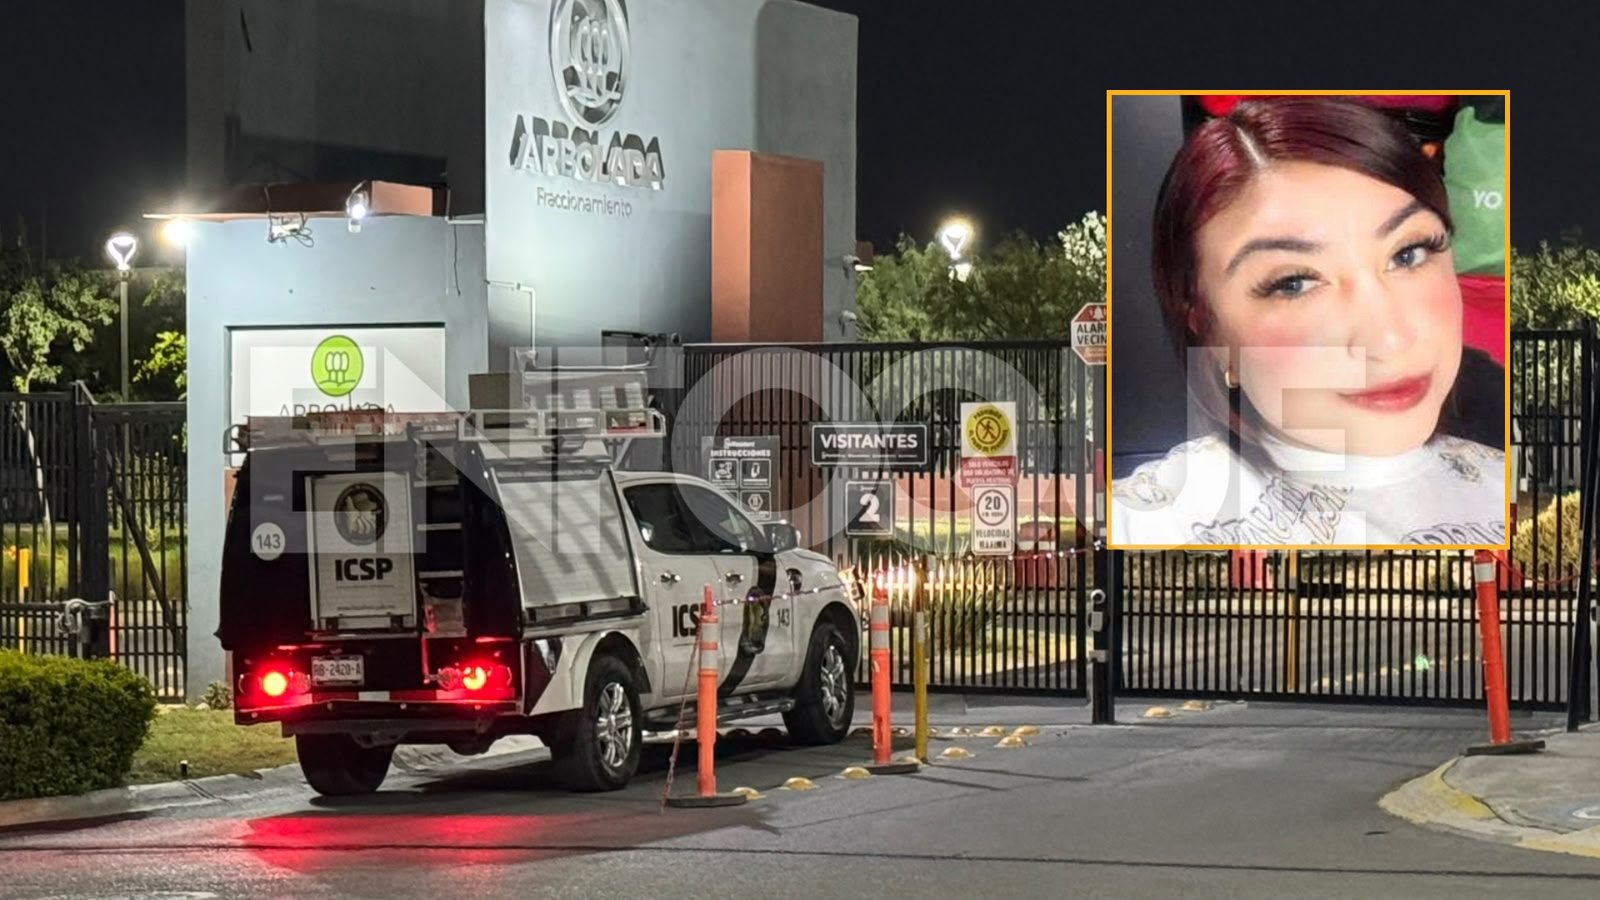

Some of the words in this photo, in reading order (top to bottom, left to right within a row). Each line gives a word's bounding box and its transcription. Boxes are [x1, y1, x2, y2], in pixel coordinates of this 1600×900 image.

[513, 125, 665, 190] ARBOLADA
[536, 186, 633, 217] Fraccionamiento
[1473, 189, 1503, 209] YO
[1077, 323, 1106, 333] ALAR
[820, 433, 918, 448] VISITANTES
[710, 449, 771, 457] INSTRUCCIONES
[859, 494, 880, 523] 2
[985, 496, 1001, 510] 20
[256, 533, 281, 549] 143
[976, 529, 1010, 538] VELOCIDAD
[335, 558, 393, 581] ICSP
[777, 608, 790, 628] 143
